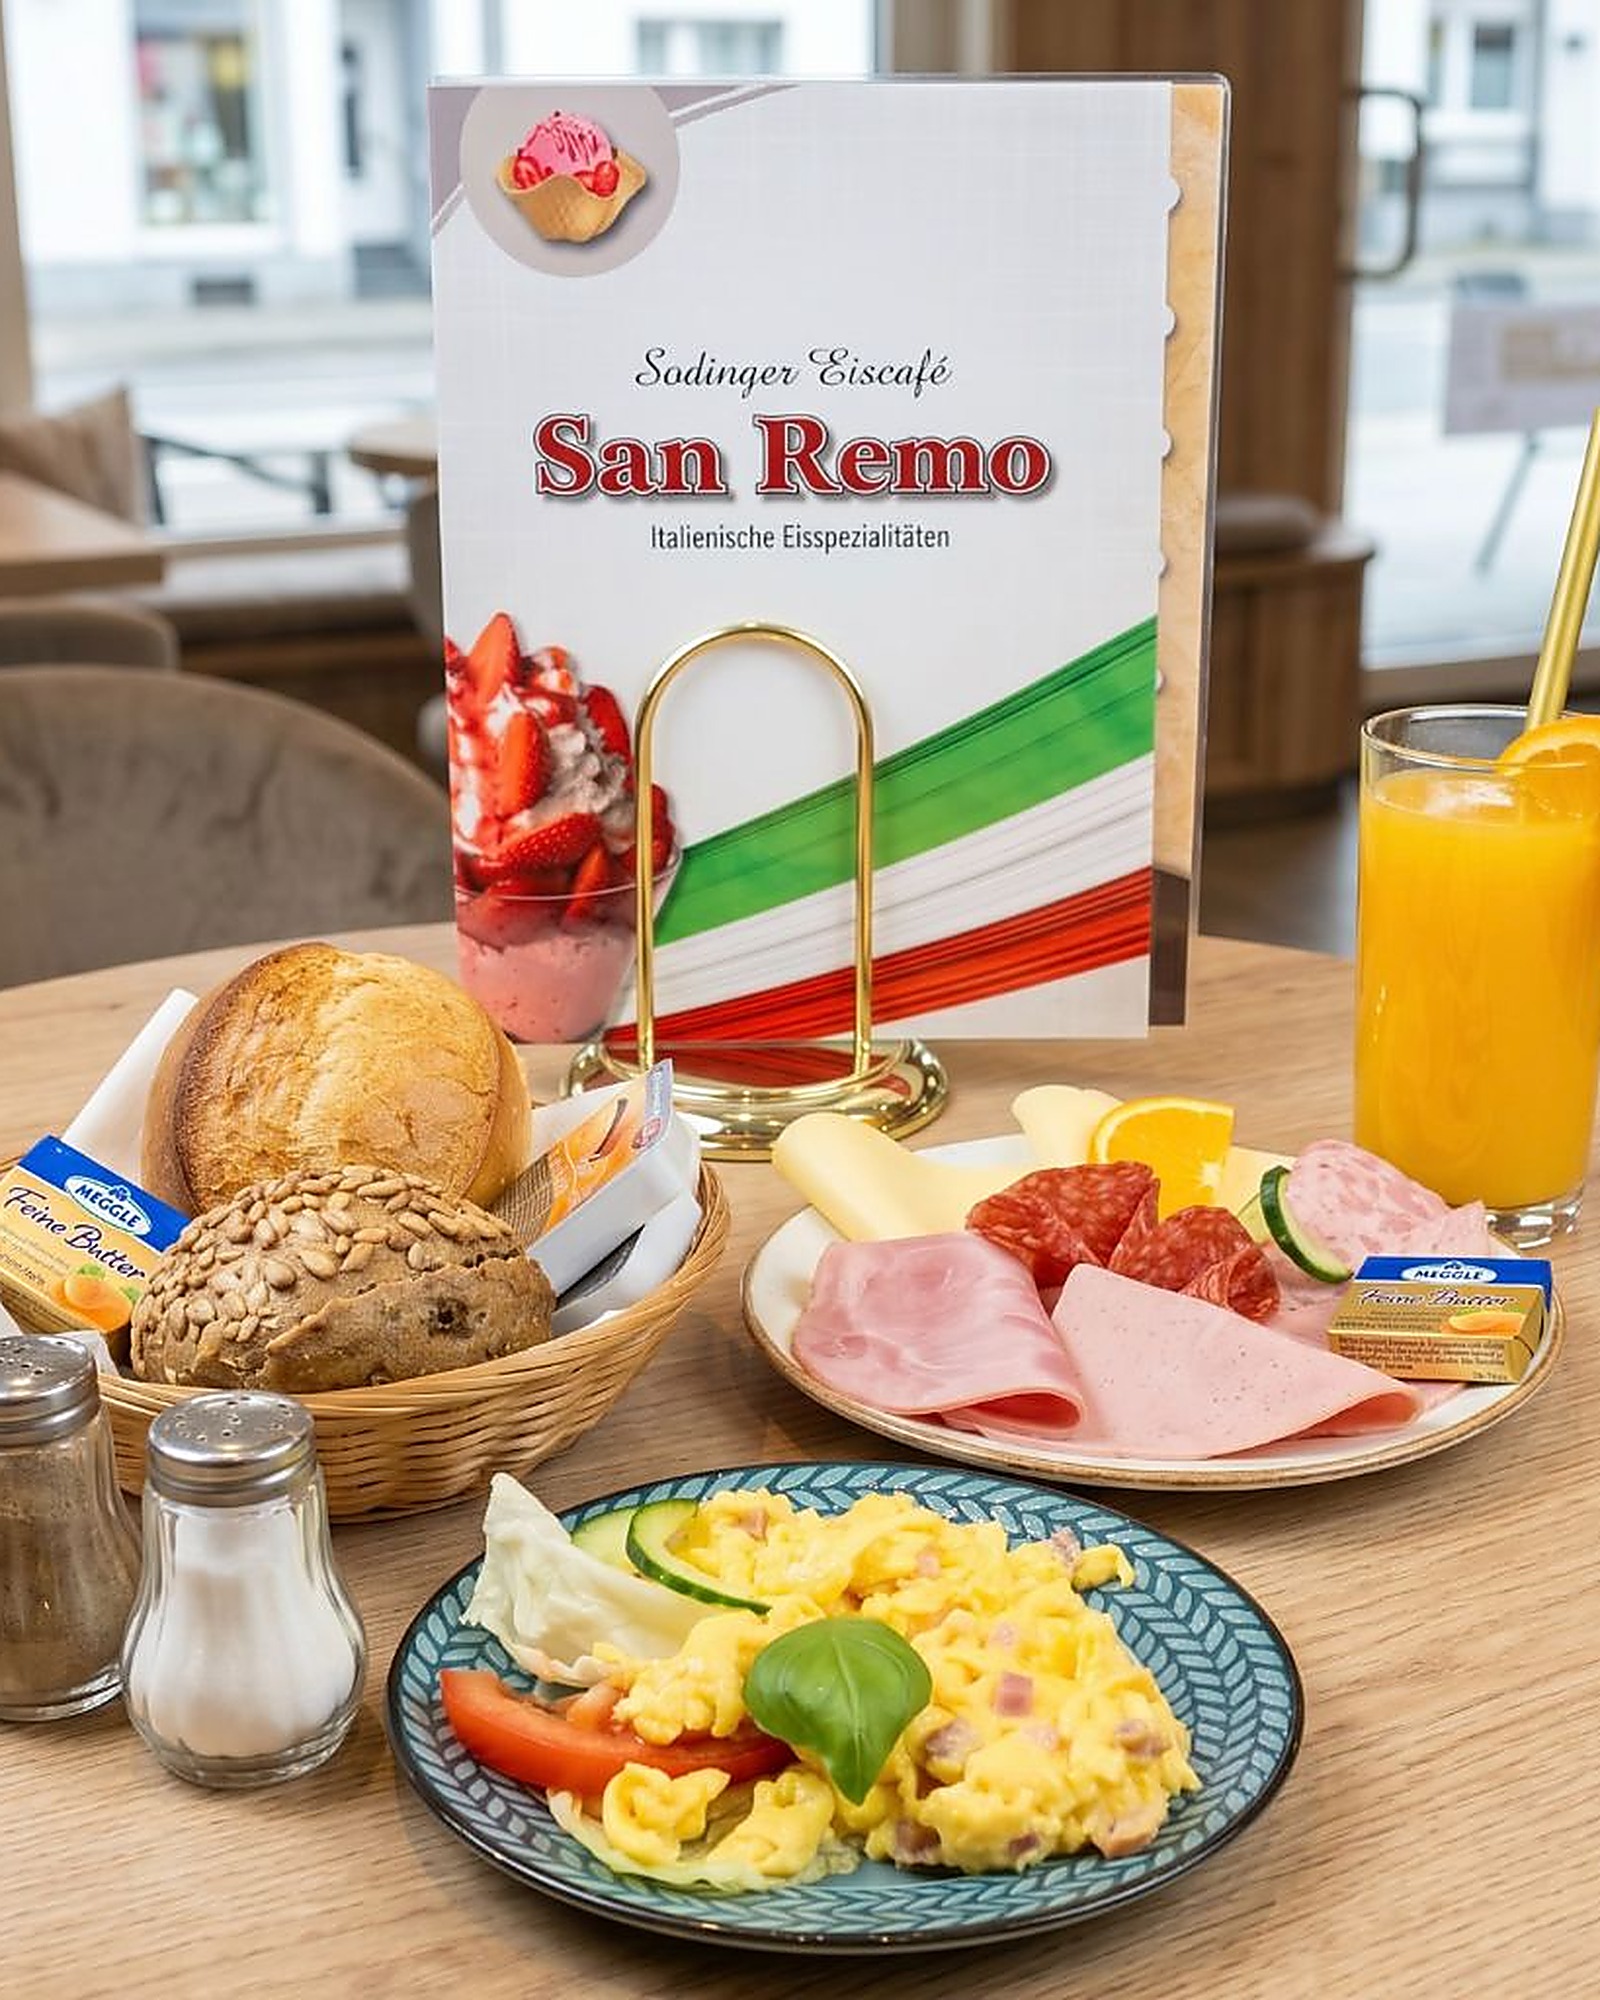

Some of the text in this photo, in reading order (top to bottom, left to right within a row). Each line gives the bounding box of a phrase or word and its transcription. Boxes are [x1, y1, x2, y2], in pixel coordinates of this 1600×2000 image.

[635, 347, 951, 399] Sodinger Eiscafé
[533, 412, 1053, 501] San Remo
[650, 523, 950, 555] Italienische Eisspezialitäten
[74, 1184, 141, 1229] MEGGLE
[3, 1186, 67, 1236] Feine
[64, 1223, 146, 1280] Butter
[1358, 1287, 1514, 1307] Feine Butter
[1413, 1268, 1483, 1281] MEGGLE
